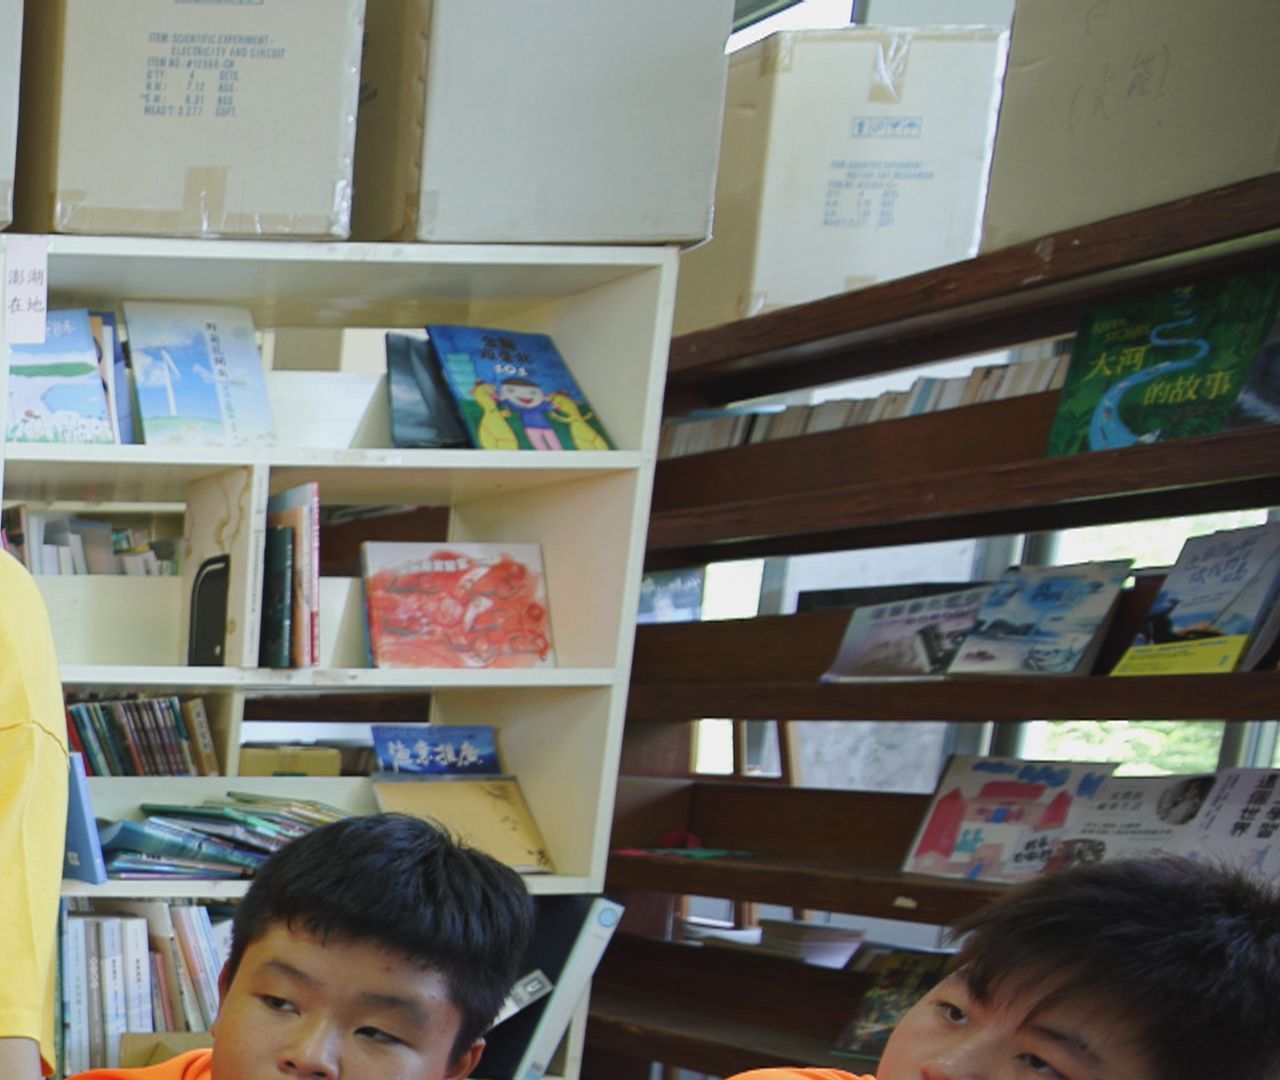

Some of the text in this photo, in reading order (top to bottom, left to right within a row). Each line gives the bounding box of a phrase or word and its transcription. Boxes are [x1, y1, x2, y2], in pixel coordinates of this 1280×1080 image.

[7, 266, 44, 287] 澎湖
[7, 298, 44, 314] 在地
[1080, 343, 1153, 382] 大河
[1143, 368, 1239, 406] 的故事
